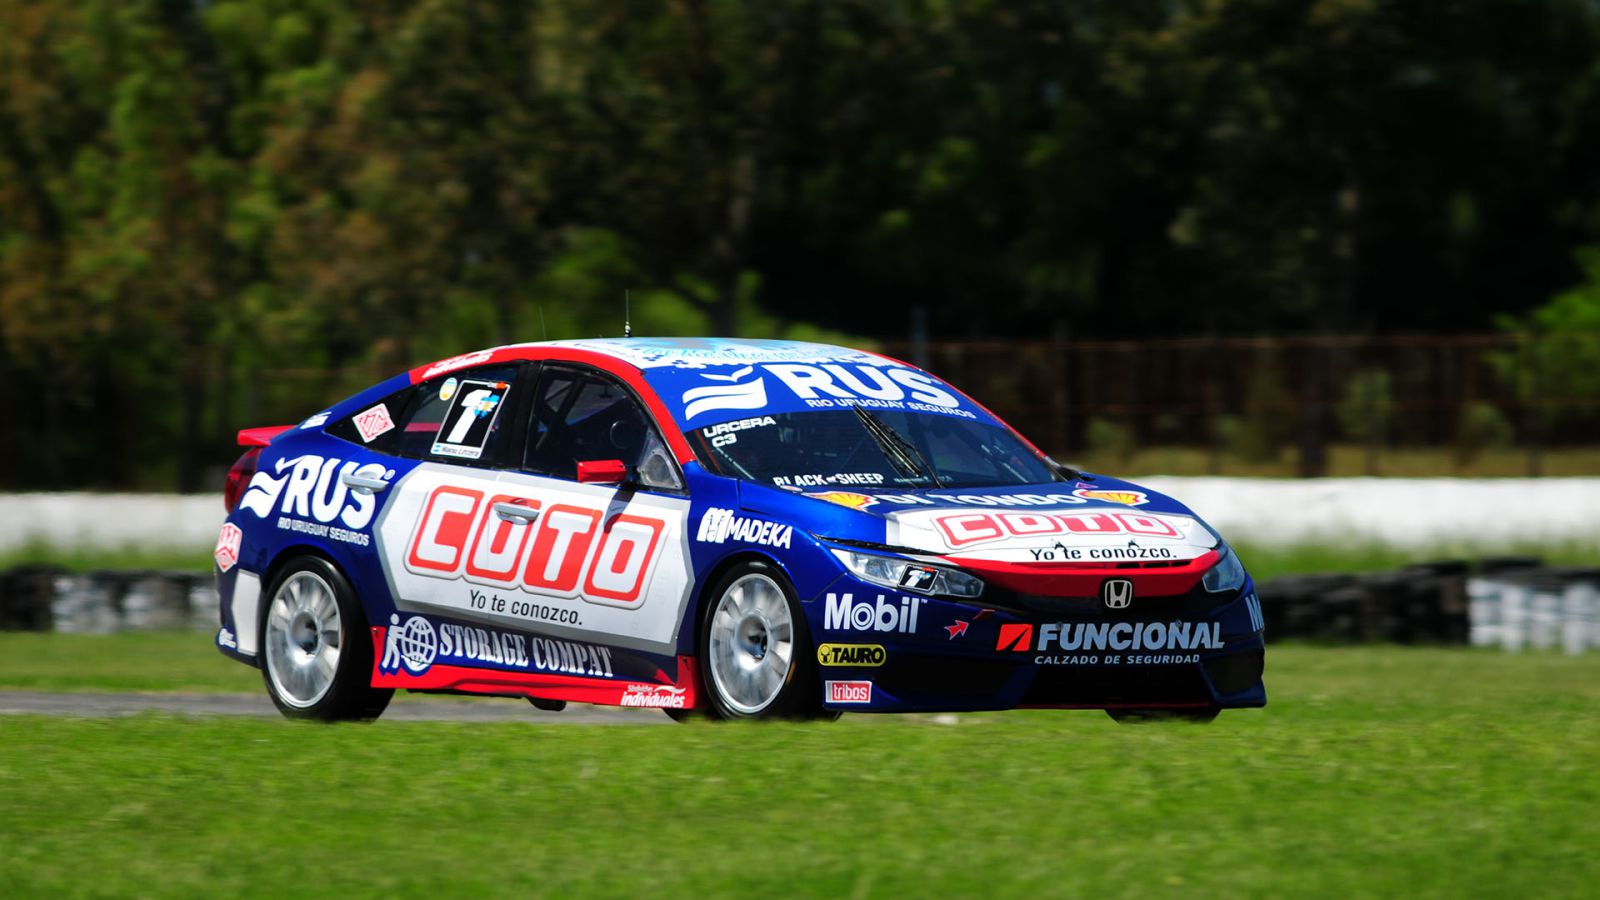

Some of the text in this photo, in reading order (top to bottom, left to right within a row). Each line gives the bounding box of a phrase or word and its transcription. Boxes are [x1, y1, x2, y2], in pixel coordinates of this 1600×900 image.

[761, 364, 960, 408] RUS
[805, 398, 977, 419] RIO URUGUAY SEGUROS
[703, 416, 776, 438] URCERA
[711, 433, 738, 448] C3
[772, 474, 829, 487] BLACK
[836, 473, 885, 485] SHEEP
[926, 494, 1087, 506] TONDO
[277, 516, 370, 547] RIO URUGUAY SEGUROS
[725, 516, 793, 550] MADEKA
[940, 514, 1172, 541] COTO
[413, 489, 658, 597] COTO
[1030, 547, 1178, 561] Yo te conozco.
[469, 588, 583, 626] Yo te conozco.
[824, 593, 920, 634] Mobil
[1037, 621, 1225, 651] FUNCIONAL
[440, 622, 614, 678] STORAGE COMPAT
[831, 647, 885, 664] TAURO
[1034, 654, 1200, 665] CALZADO DE SEGURIDAD
[620, 691, 686, 708] individuales
[833, 684, 868, 700] tribos
